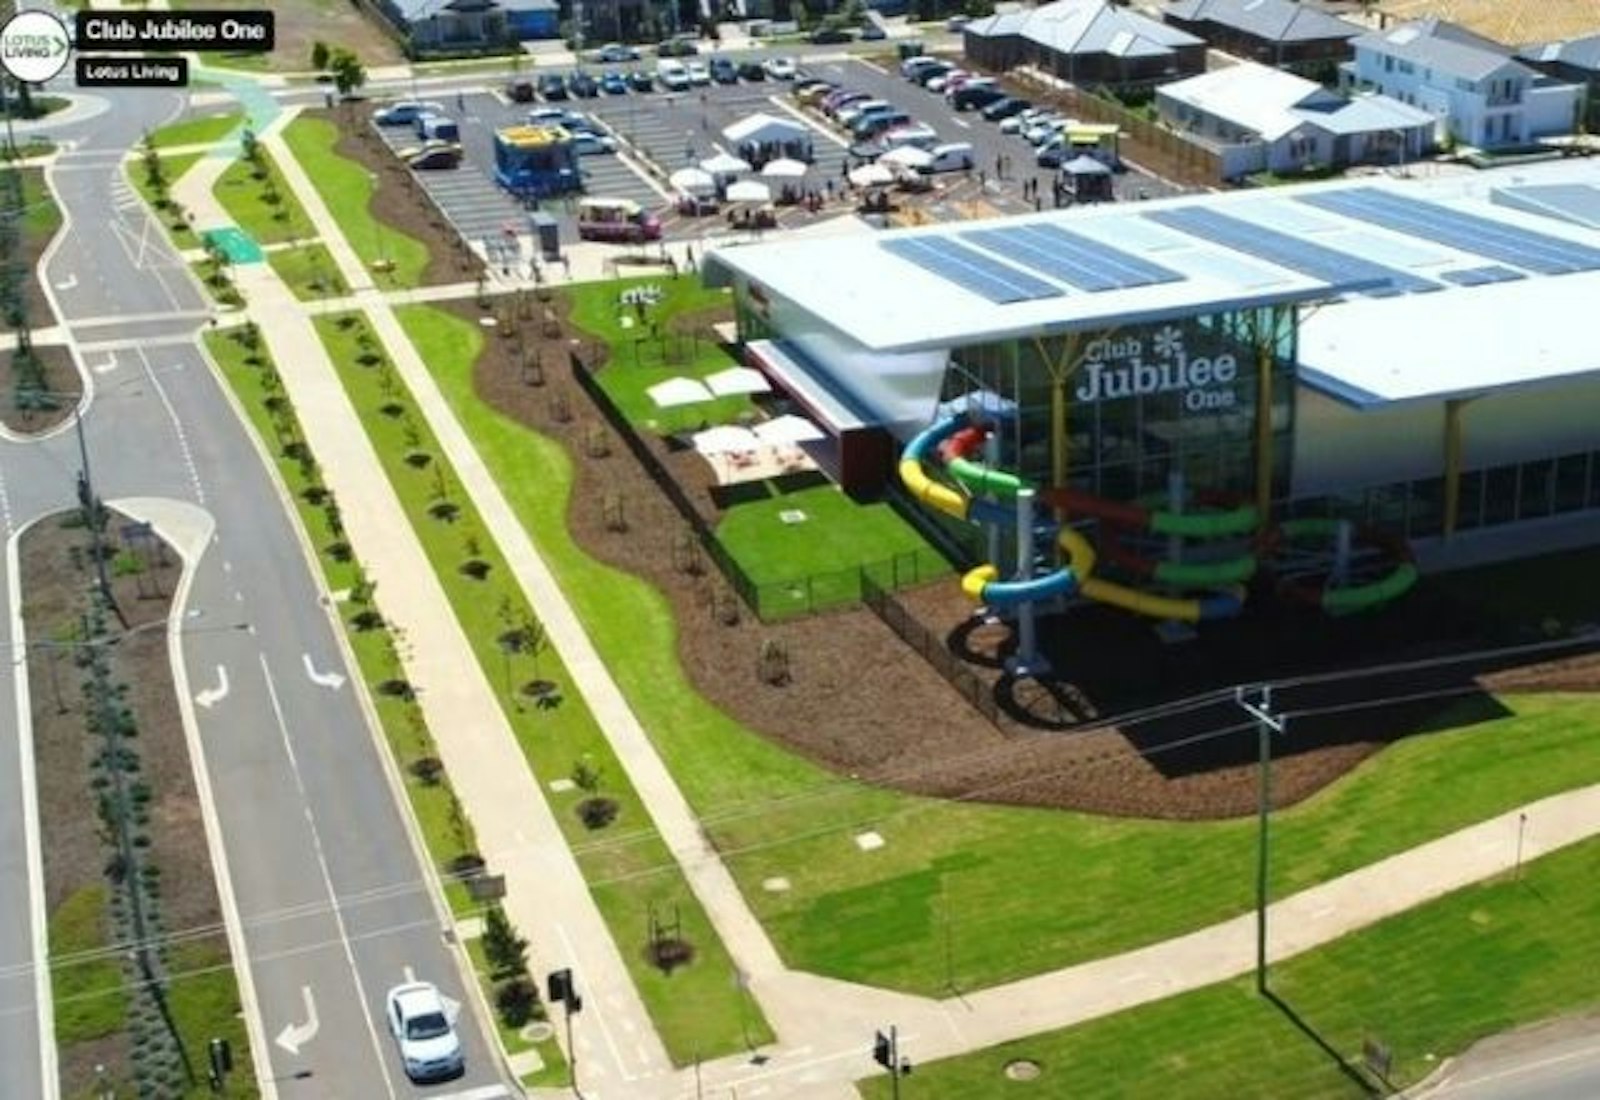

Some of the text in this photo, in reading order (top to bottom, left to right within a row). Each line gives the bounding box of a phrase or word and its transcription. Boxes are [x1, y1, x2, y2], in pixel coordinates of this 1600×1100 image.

[1086, 337, 1141, 361] Club
[1076, 351, 1236, 401] Jubilee
[1186, 389, 1235, 411] One
